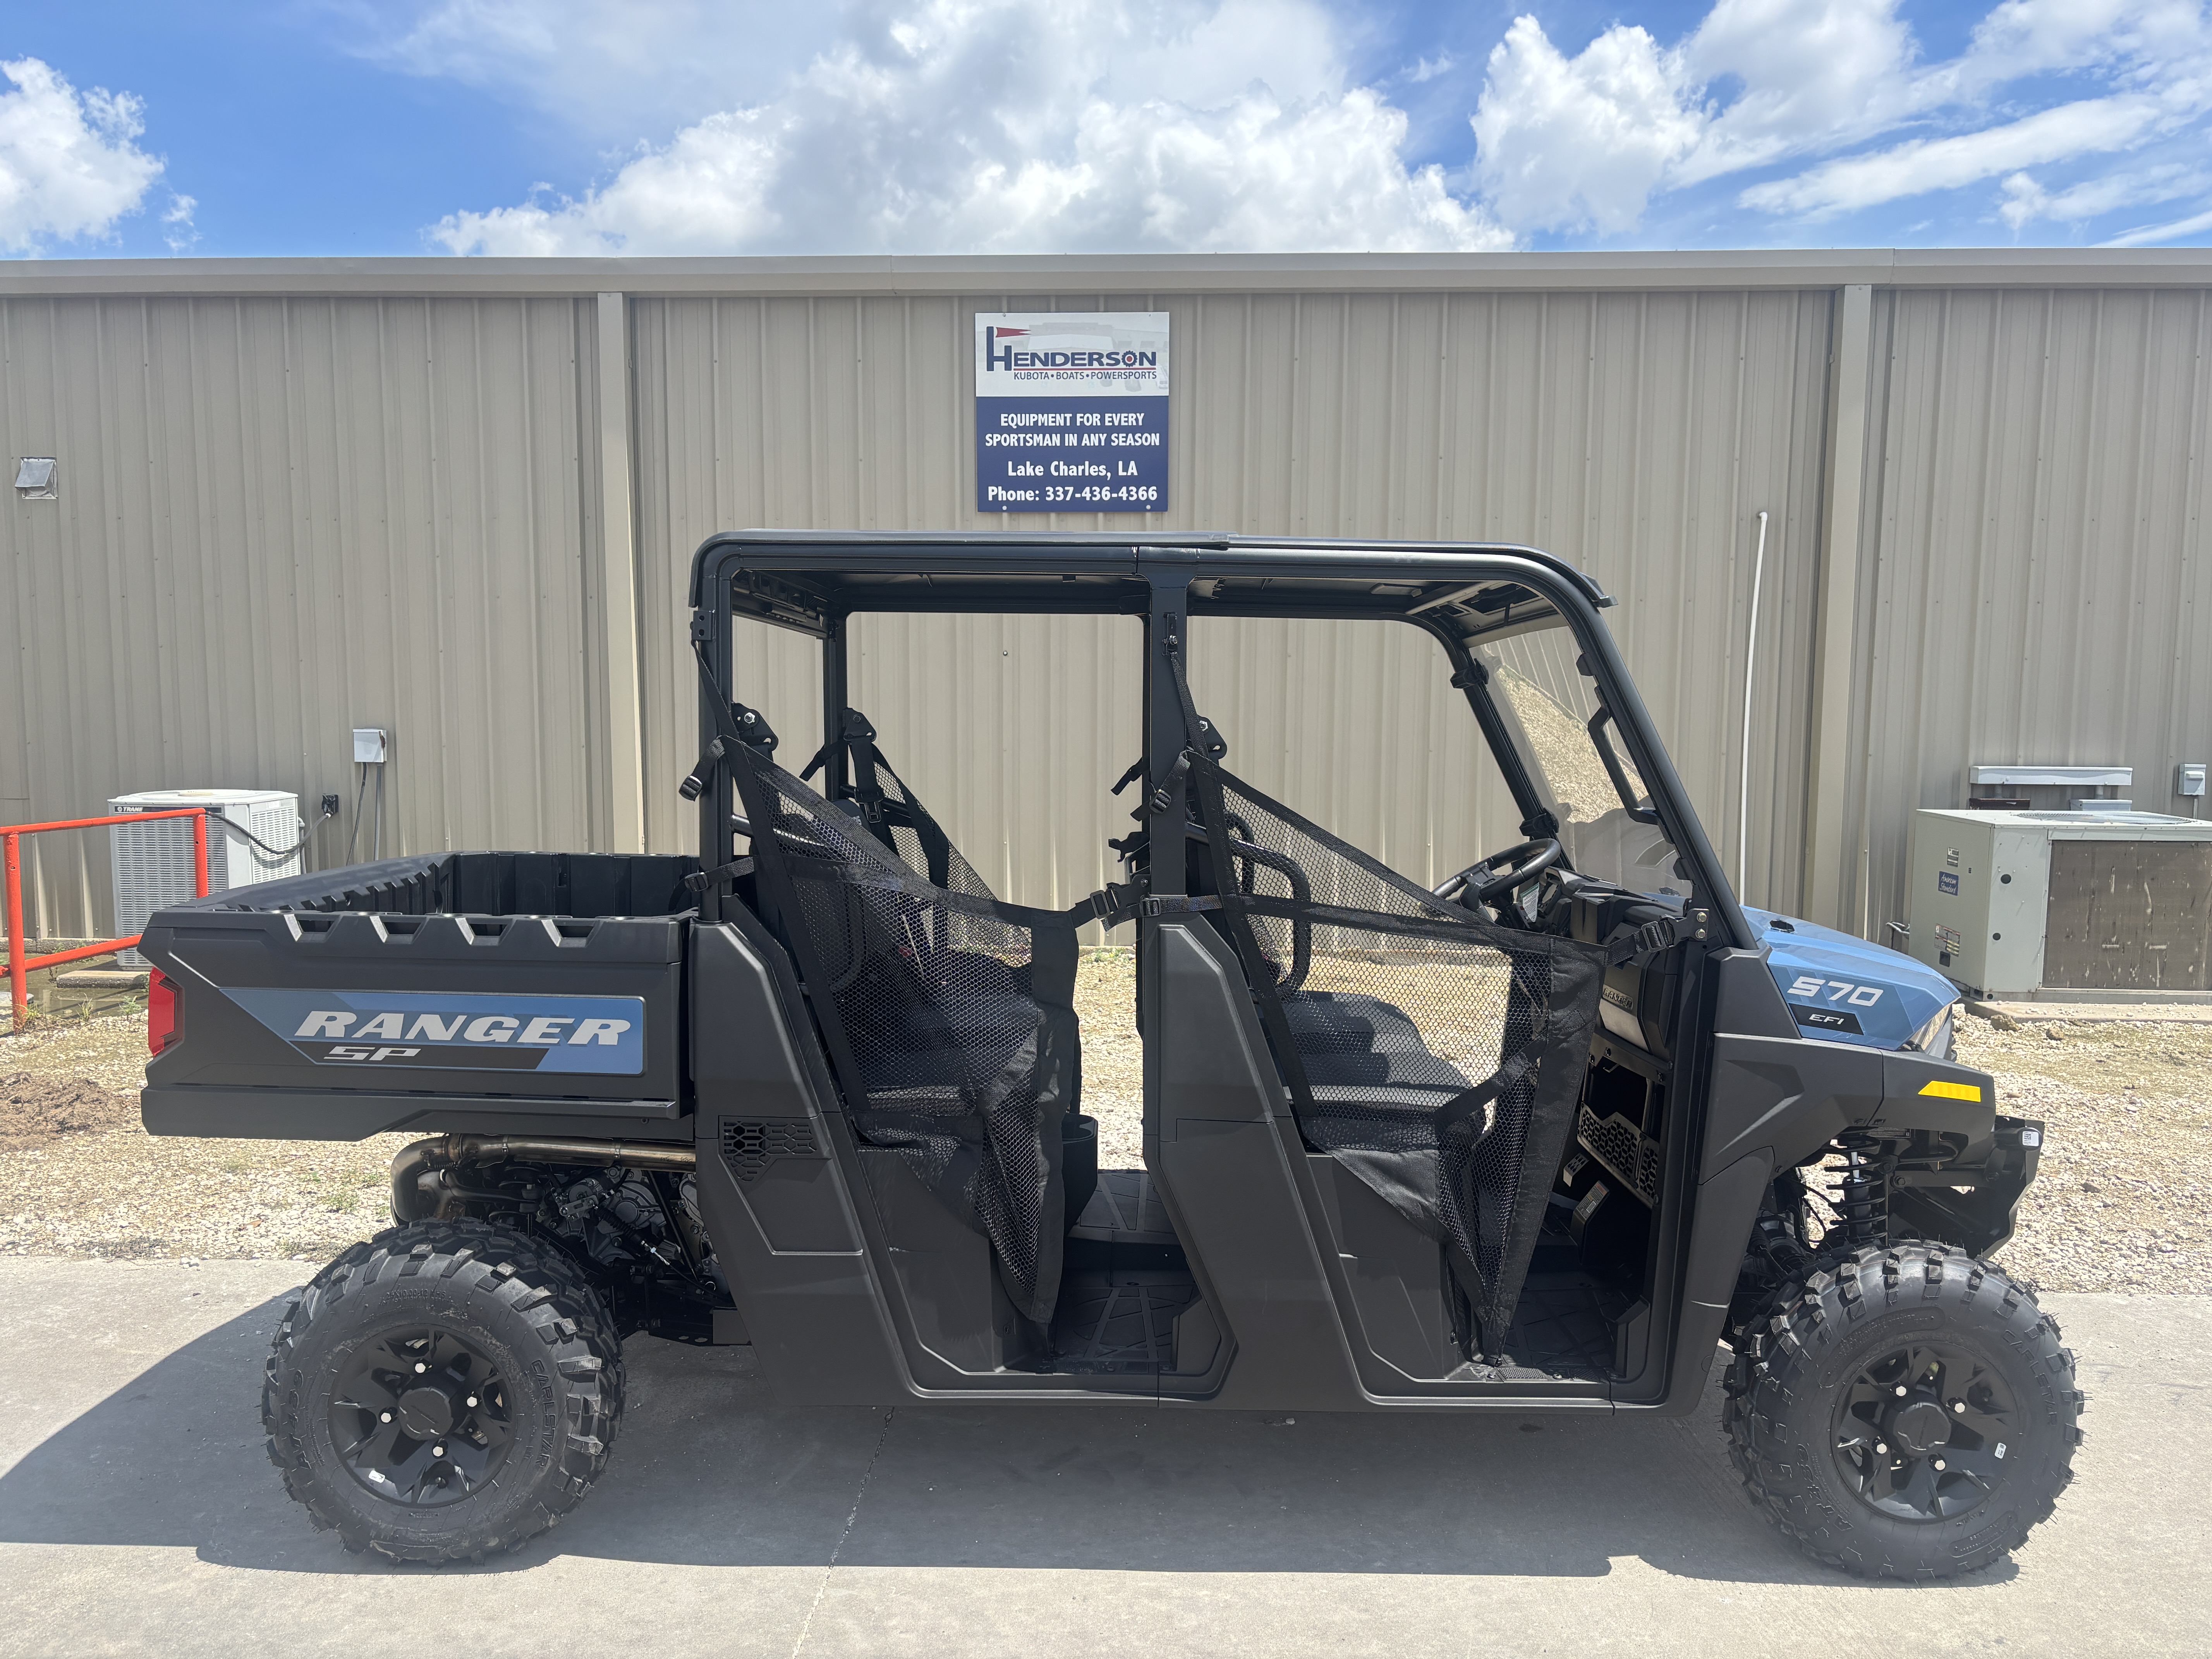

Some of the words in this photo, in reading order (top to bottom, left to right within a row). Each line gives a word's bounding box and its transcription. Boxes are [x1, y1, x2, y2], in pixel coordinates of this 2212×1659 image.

[986, 326, 1156, 371] HENDERSON
[1013, 372, 1049, 380] KUBOTA
[1091, 371, 1157, 380] POWERSPORTS
[1000, 414, 1072, 428] EQUIPMENT
[1077, 414, 1101, 426] FOR
[1105, 413, 1144, 426] EVERY
[985, 434, 1060, 447] SPORTSMAN
[1065, 434, 1077, 446] IN
[1081, 433, 1107, 446] ANY
[1111, 433, 1160, 446] SEASON
[1008, 461, 1044, 476] Lake
[1050, 461, 1111, 481] Charles,
[1118, 461, 1138, 476] LA
[988, 486, 1039, 501] Phone:
[1045, 486, 1158, 501] 337-436-4366
[1787, 976, 1884, 1007] 570
[294, 1010, 632, 1046] RANGER
[1809, 1014, 1844, 1025] EFI
[323, 1046, 421, 1061] SP
[2002, 1329, 2057, 1426] CARLSTAR
[531, 1358, 556, 1468] CARLSTAR
